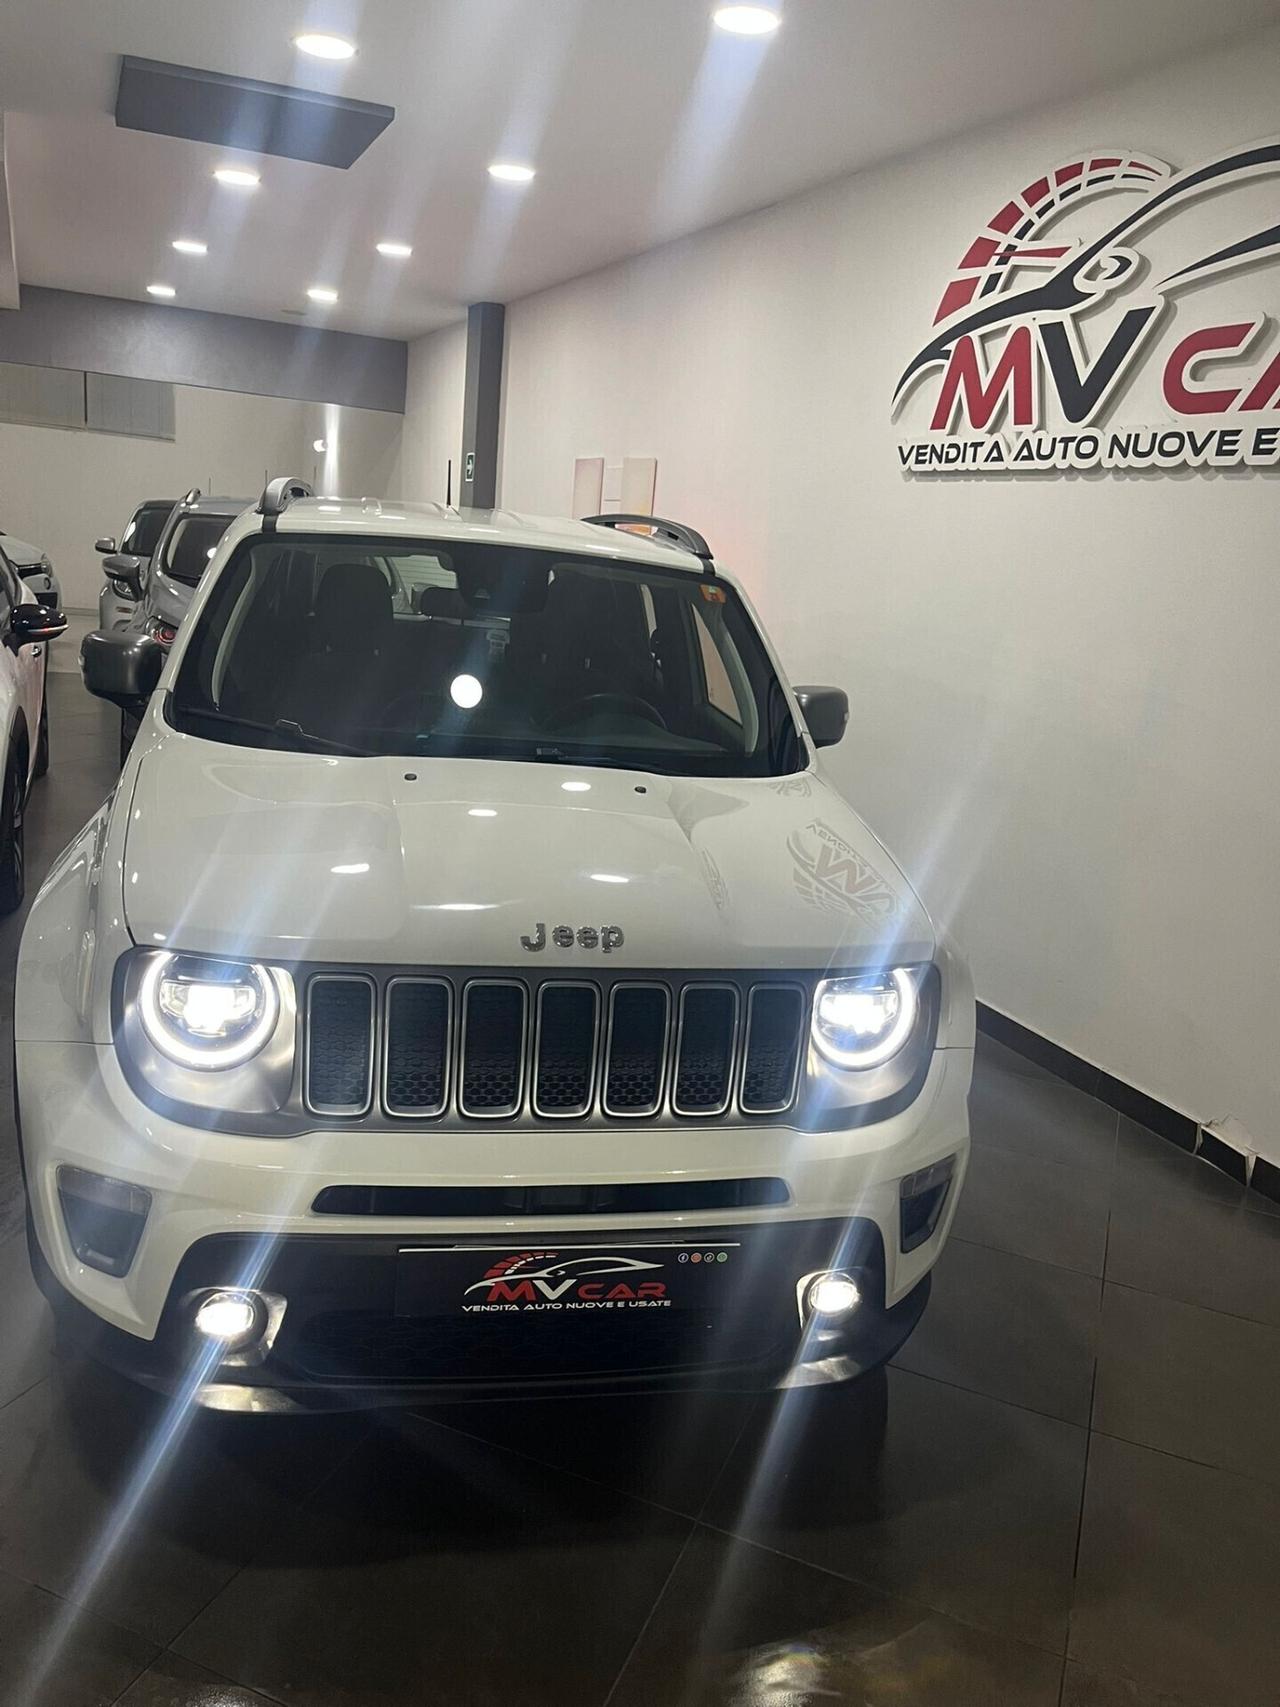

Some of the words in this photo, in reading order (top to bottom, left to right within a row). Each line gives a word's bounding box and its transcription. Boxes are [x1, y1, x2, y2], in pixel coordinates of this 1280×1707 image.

[898, 440, 1004, 466] VENDITA
[1013, 434, 1099, 462] AUTO
[1107, 429, 1243, 459] NUOVE
[1251, 427, 1280, 456] E
[520, 922, 624, 953] Jeep
[462, 1304, 520, 1312] VENDITA
[523, 1302, 563, 1310] AUTO
[566, 1301, 614, 1309] NUOVE
[617, 1300, 626, 1308] E
[628, 1299, 672, 1308] USATE
